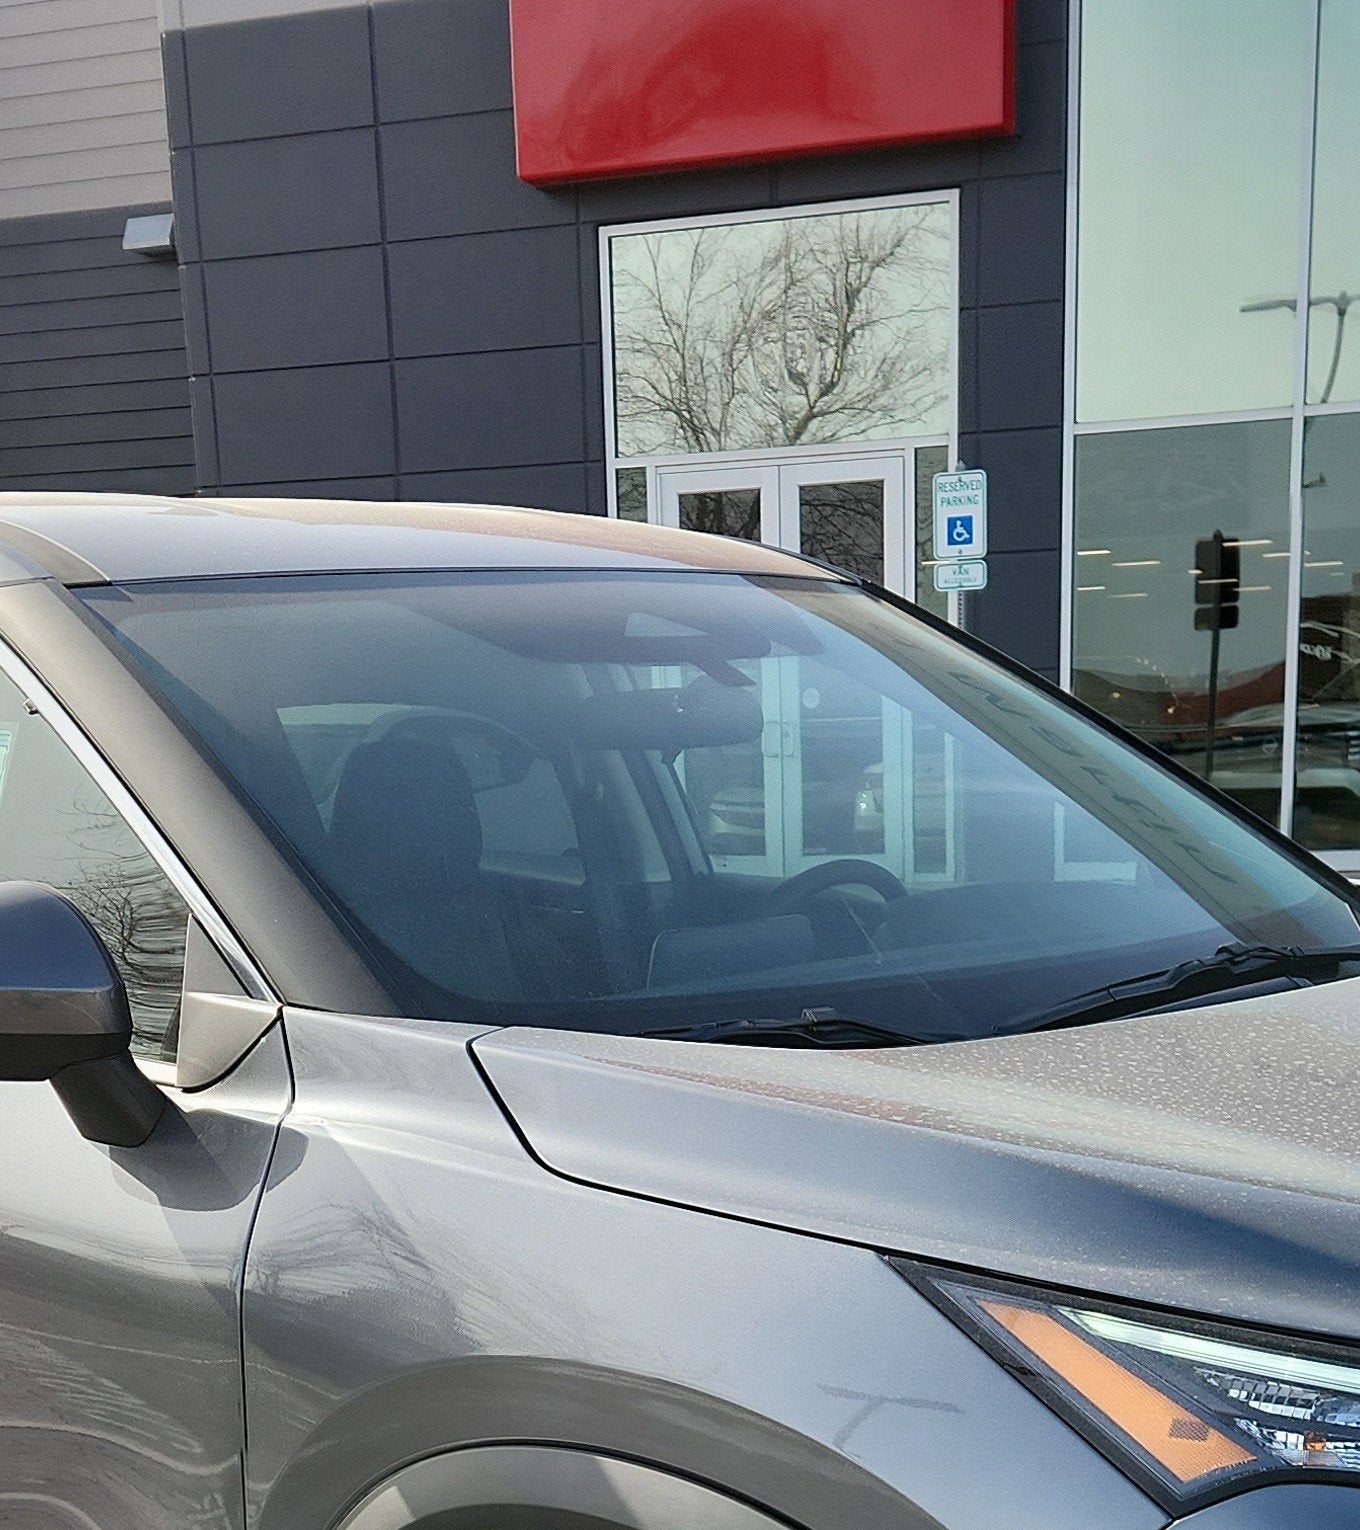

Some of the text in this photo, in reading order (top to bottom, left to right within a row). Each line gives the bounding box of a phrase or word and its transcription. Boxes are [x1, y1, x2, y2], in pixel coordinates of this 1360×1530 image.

[938, 479, 982, 493] RESERVED
[940, 494, 979, 507] PARKING
[952, 566, 970, 576] VAN
